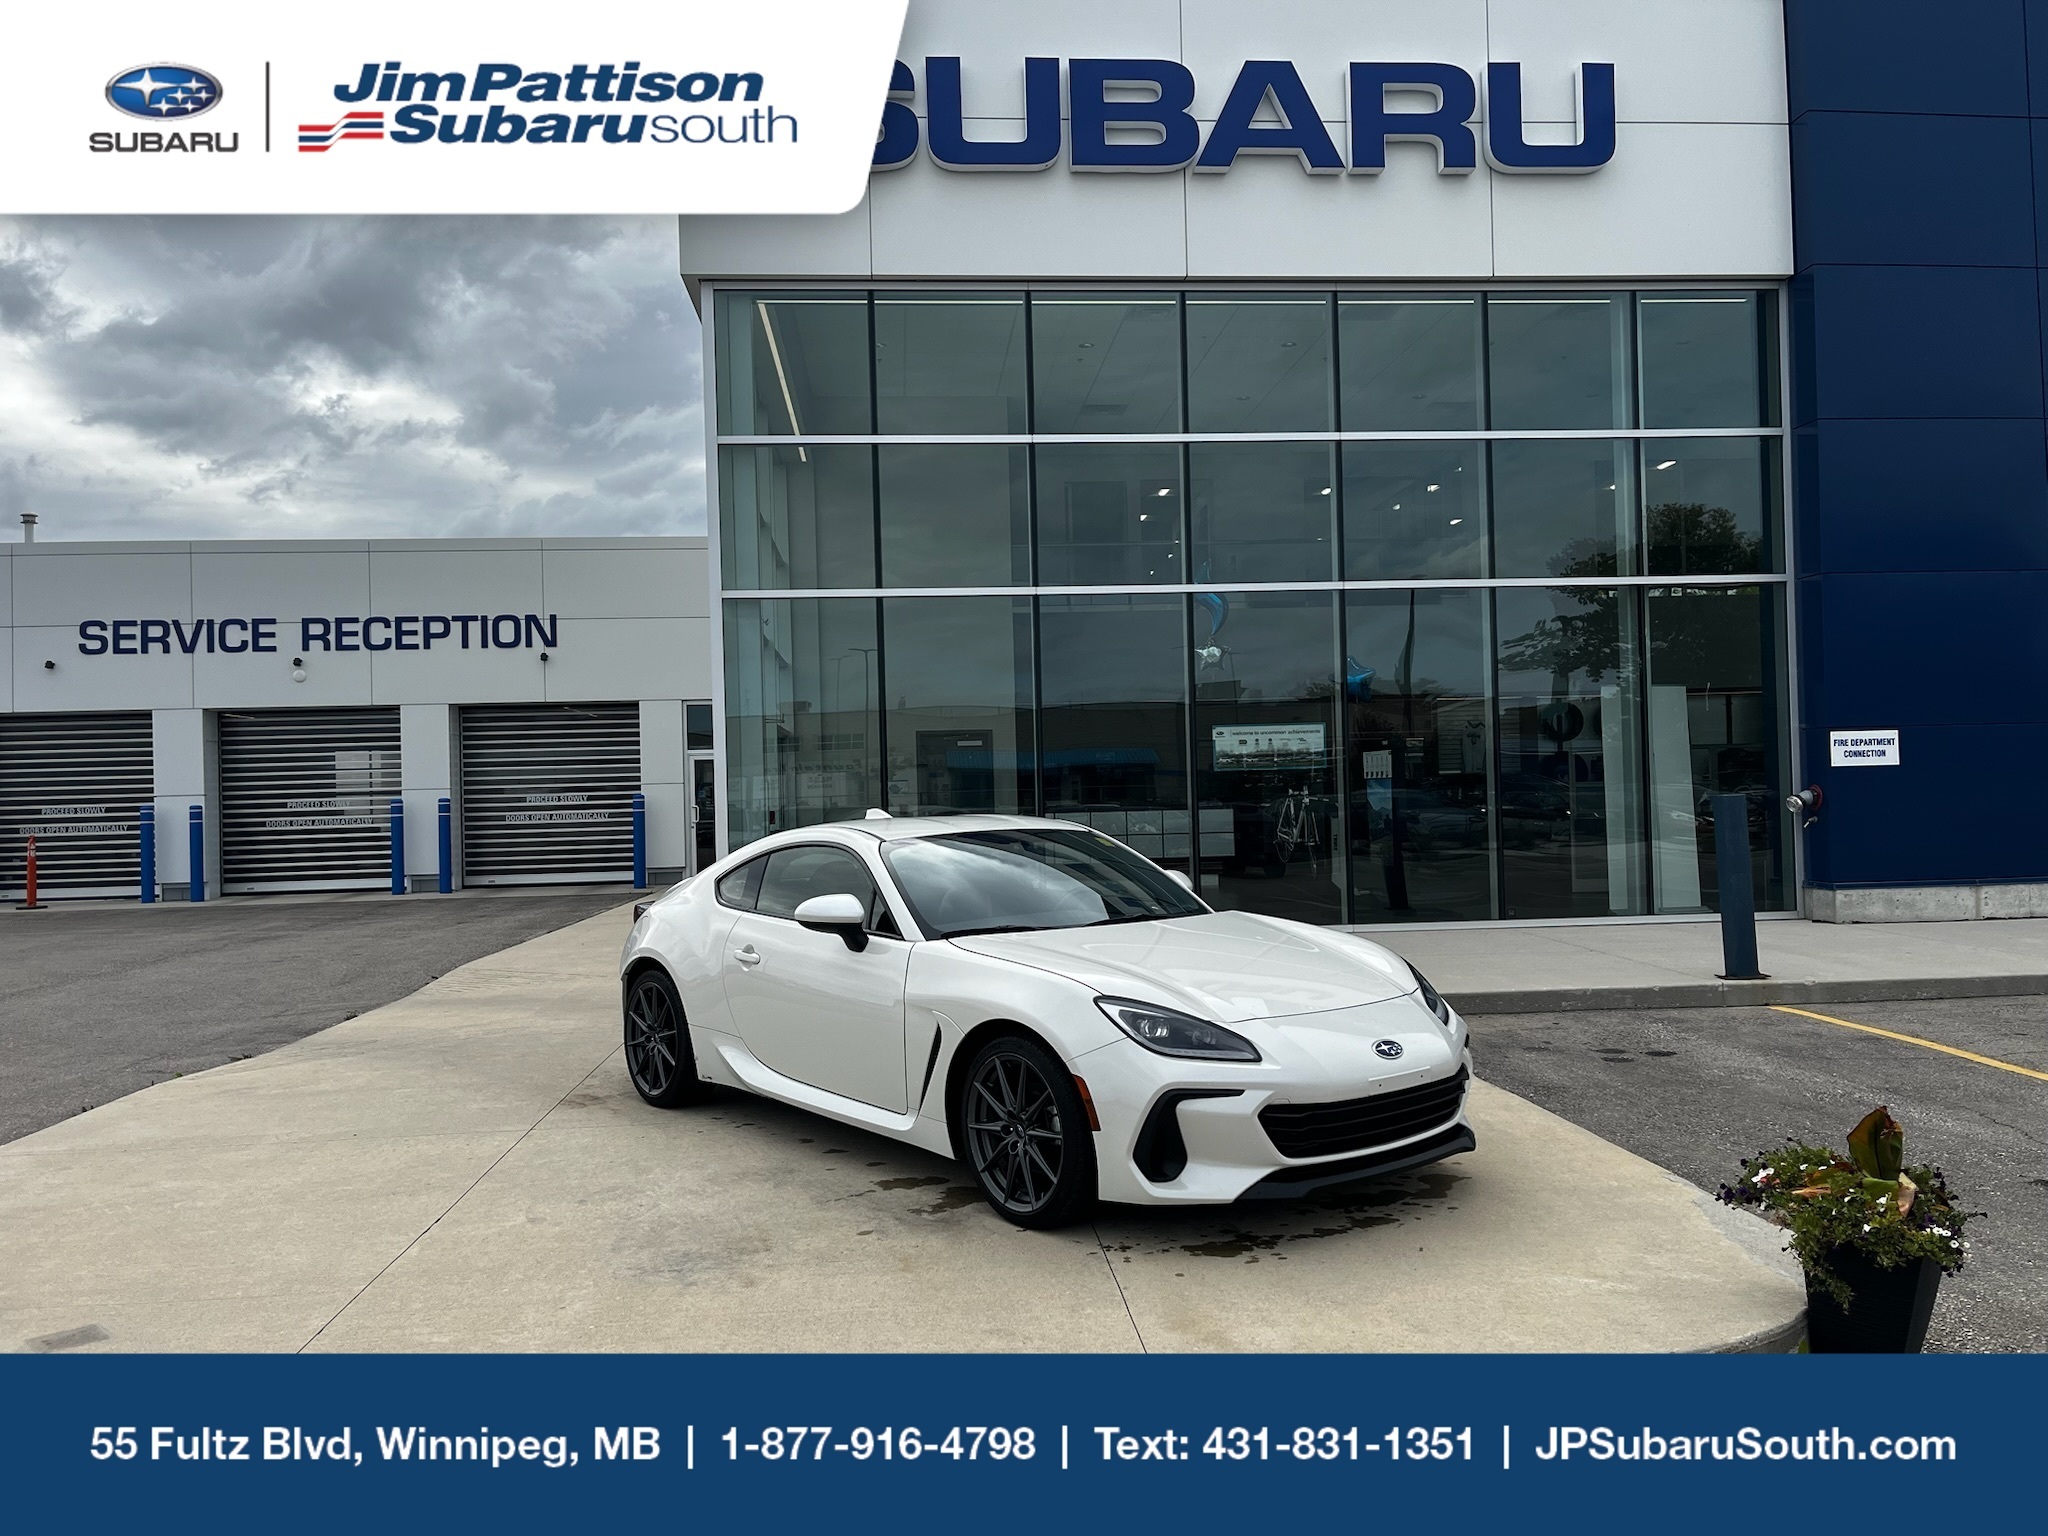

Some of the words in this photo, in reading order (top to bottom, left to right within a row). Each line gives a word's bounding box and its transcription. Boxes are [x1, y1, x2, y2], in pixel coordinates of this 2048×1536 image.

[78, 618, 278, 655] SERVICE
[301, 614, 558, 652] RECEPTION
[1833, 738, 1849, 747] FIRE
[1850, 738, 1896, 747] DEPARTMENT
[1843, 749, 1887, 758] CONNECTION
[526, 795, 559, 803] PROCEED
[560, 794, 589, 802] SLOWLY
[287, 801, 320, 809] PROCEED
[321, 800, 351, 808] SLOWLY
[41, 807, 75, 816] PROCEED
[76, 806, 106, 815] SLOWLY
[505, 814, 530, 822] DOORS
[531, 813, 551, 821] OPEN
[551, 812, 609, 821] AUTOMATICALLY
[266, 820, 291, 828] DOORS
[292, 819, 312, 827] OPEN
[313, 817, 374, 826] AUTOMATICALLY
[19, 826, 45, 835] DOORS
[45, 825, 67, 834] OPEN
[67, 824, 129, 833] AUTOMATICALLY
